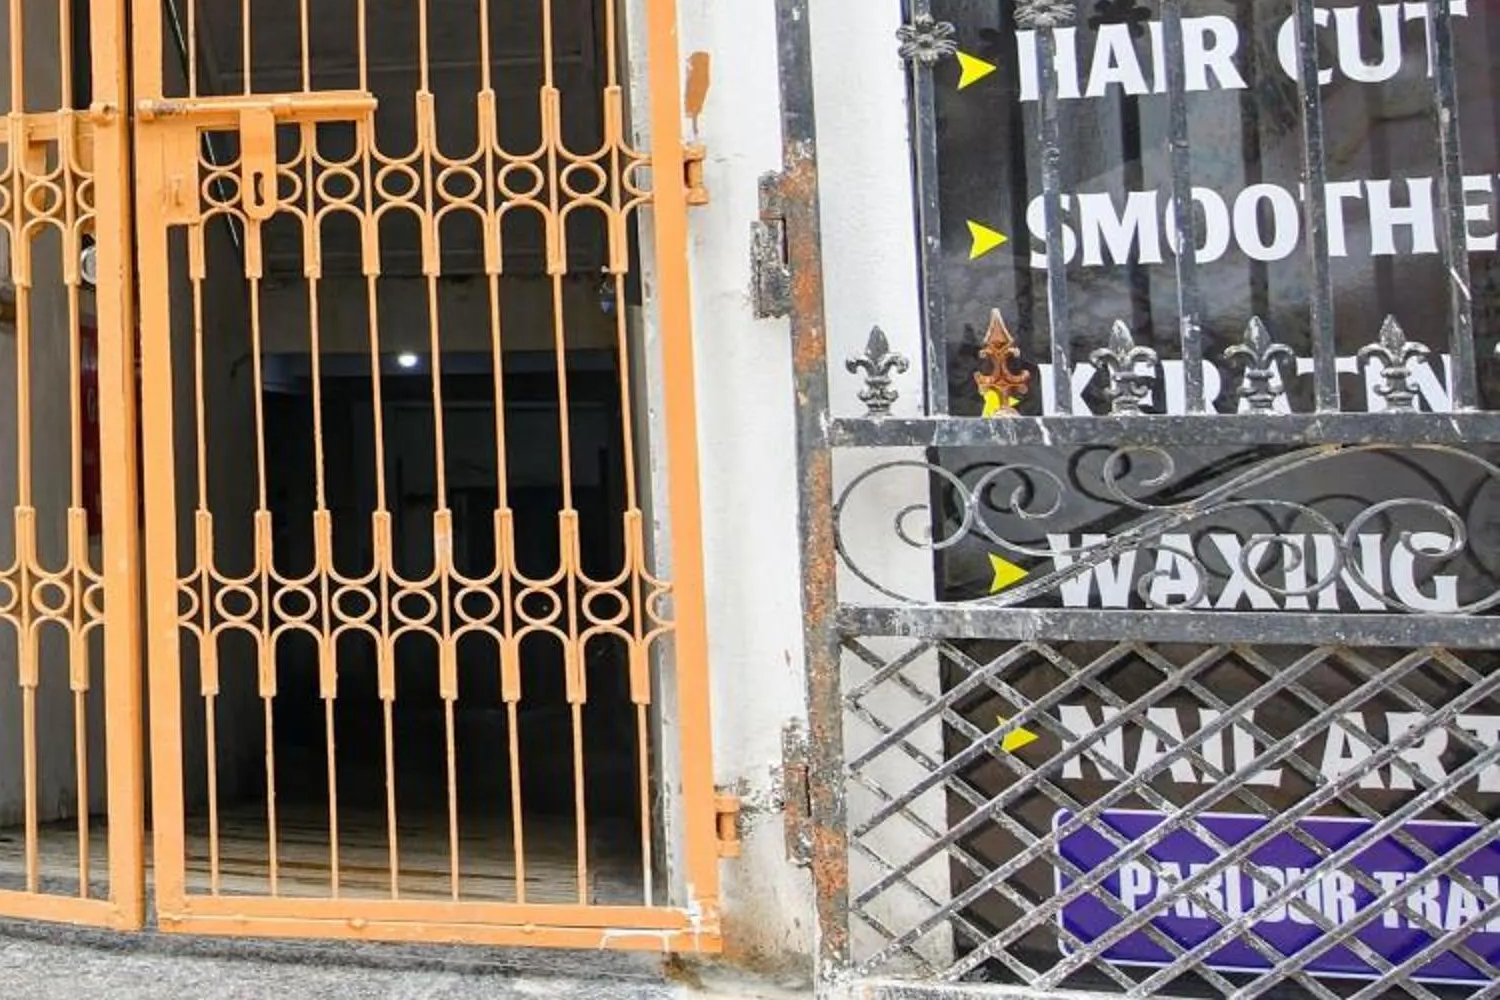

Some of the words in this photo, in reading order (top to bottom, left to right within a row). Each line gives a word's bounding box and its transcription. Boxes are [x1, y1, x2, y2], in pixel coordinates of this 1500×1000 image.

[1014, 14, 1248, 102] HAIR
[1047, 532, 1461, 613] WAXING
[1058, 704, 1283, 788] NAIL
